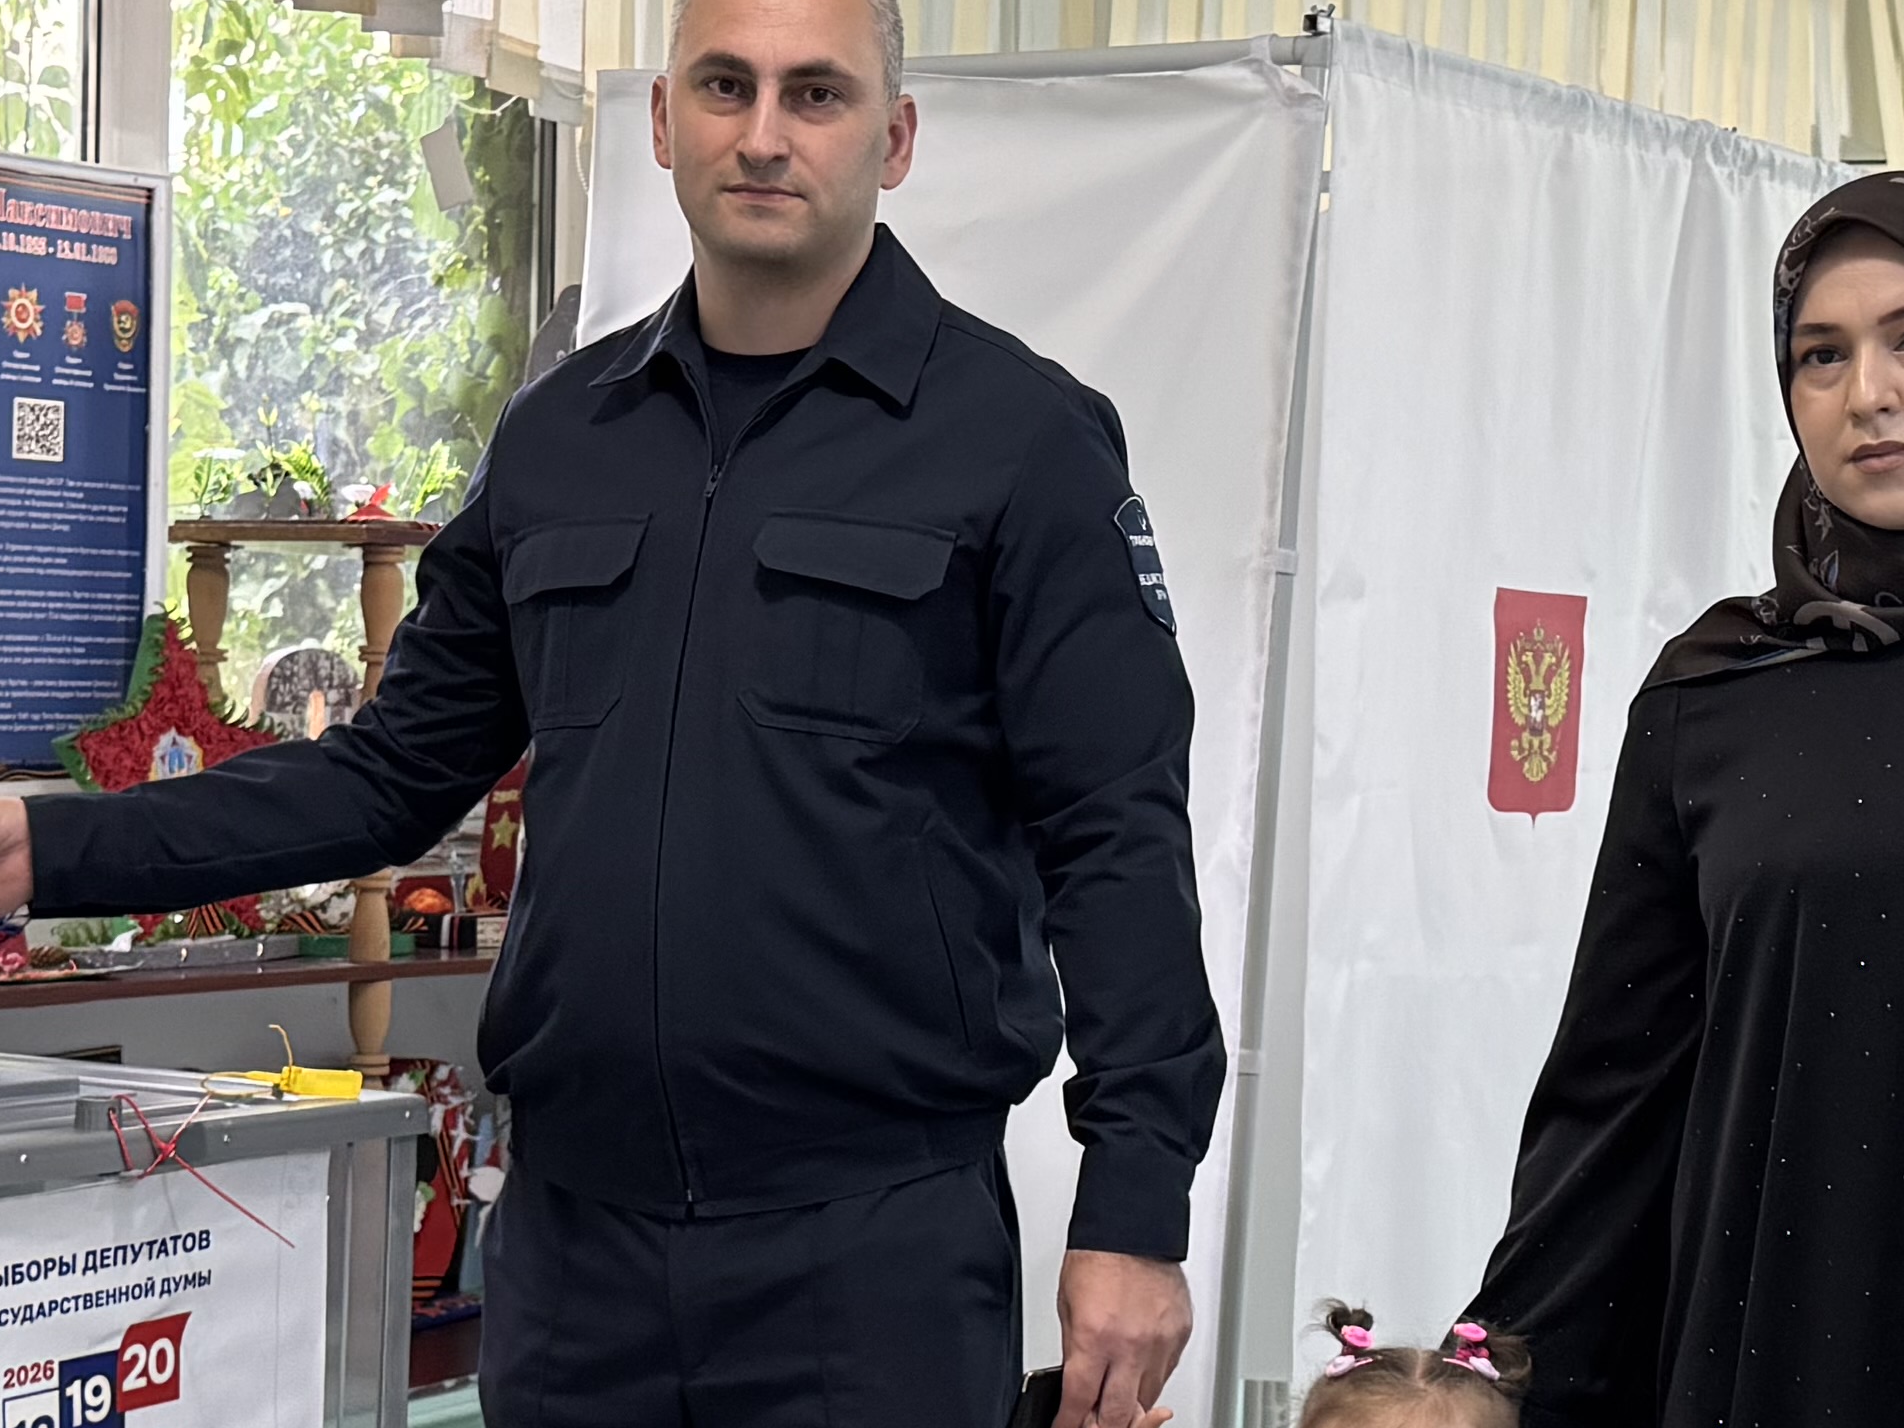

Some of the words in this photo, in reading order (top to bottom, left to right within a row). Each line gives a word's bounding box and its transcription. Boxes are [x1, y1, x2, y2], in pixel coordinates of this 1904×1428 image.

[82, 1229, 212, 1276] ДЕПУТАТОВ
[160, 1270, 212, 1296] ДУМЫ
[3, 1360, 54, 1388] 2026
[66, 1376, 111, 1428] 19
[122, 1337, 175, 1392] 20
